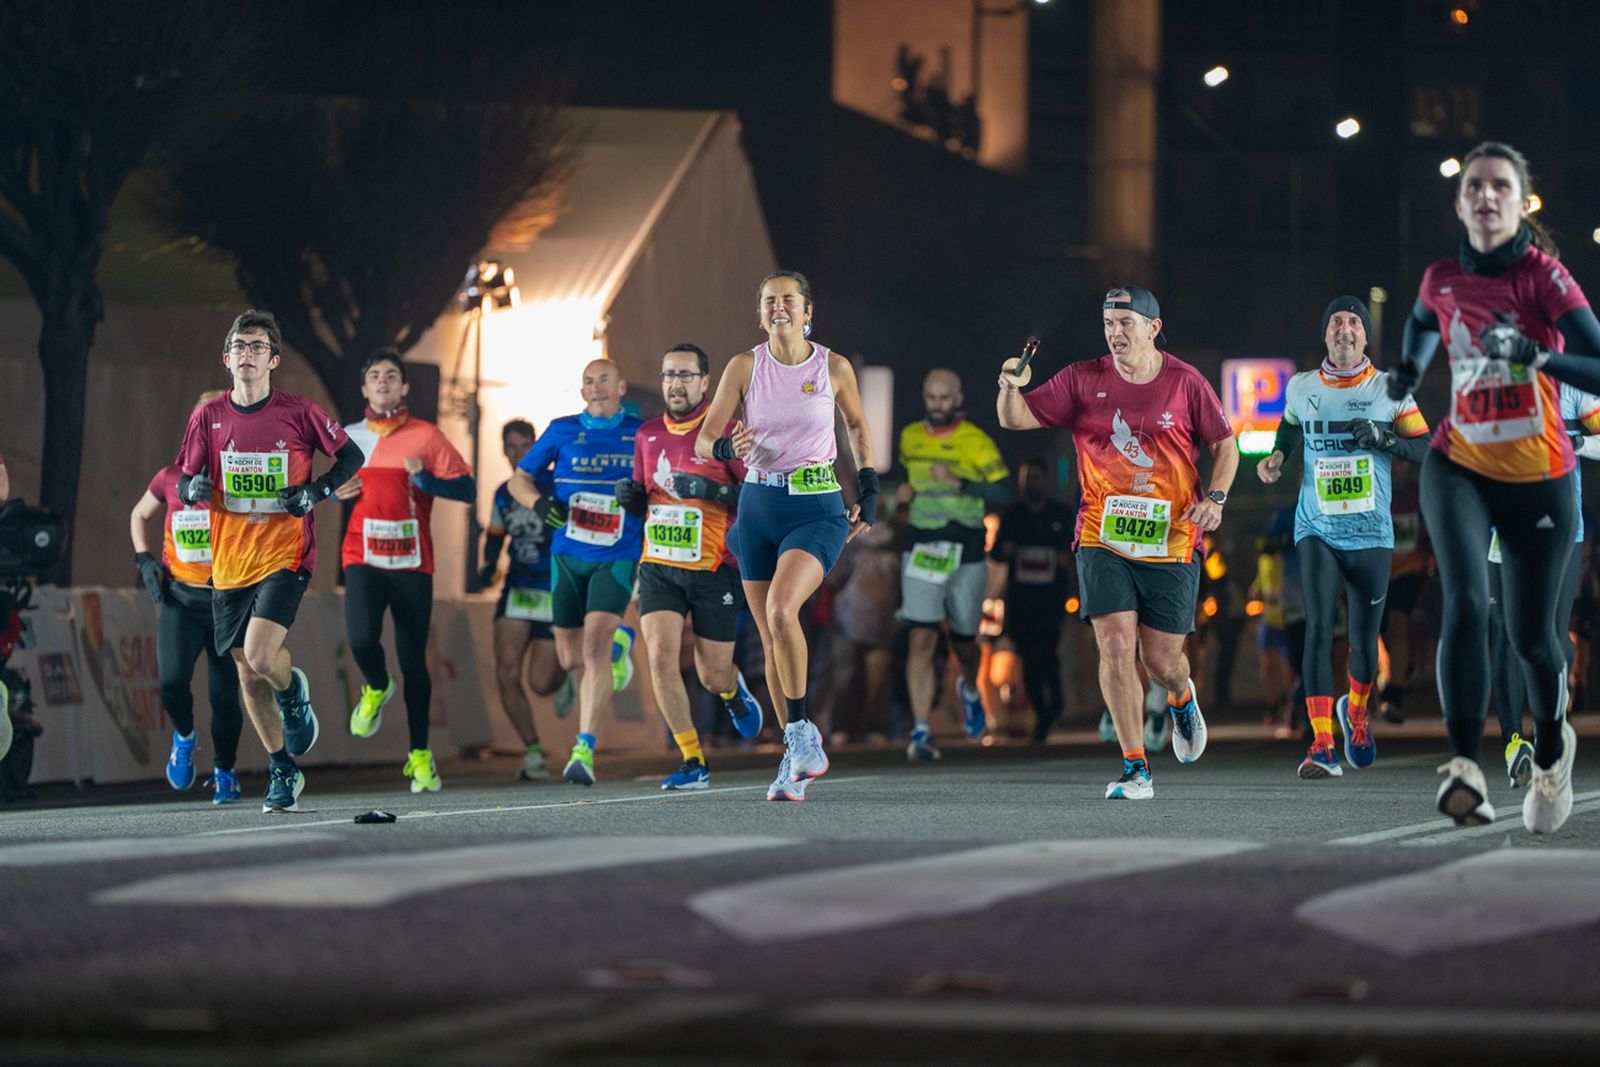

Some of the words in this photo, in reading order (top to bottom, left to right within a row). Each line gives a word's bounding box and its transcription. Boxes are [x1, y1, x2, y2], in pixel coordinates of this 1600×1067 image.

[1123, 441, 1140, 458] 43
[232, 474, 276, 492] 6590
[1118, 502, 1139, 510] NOCHE
[1139, 503, 1148, 511] DE
[653, 524, 692, 543] 13134
[1115, 516, 1156, 538] 9473
